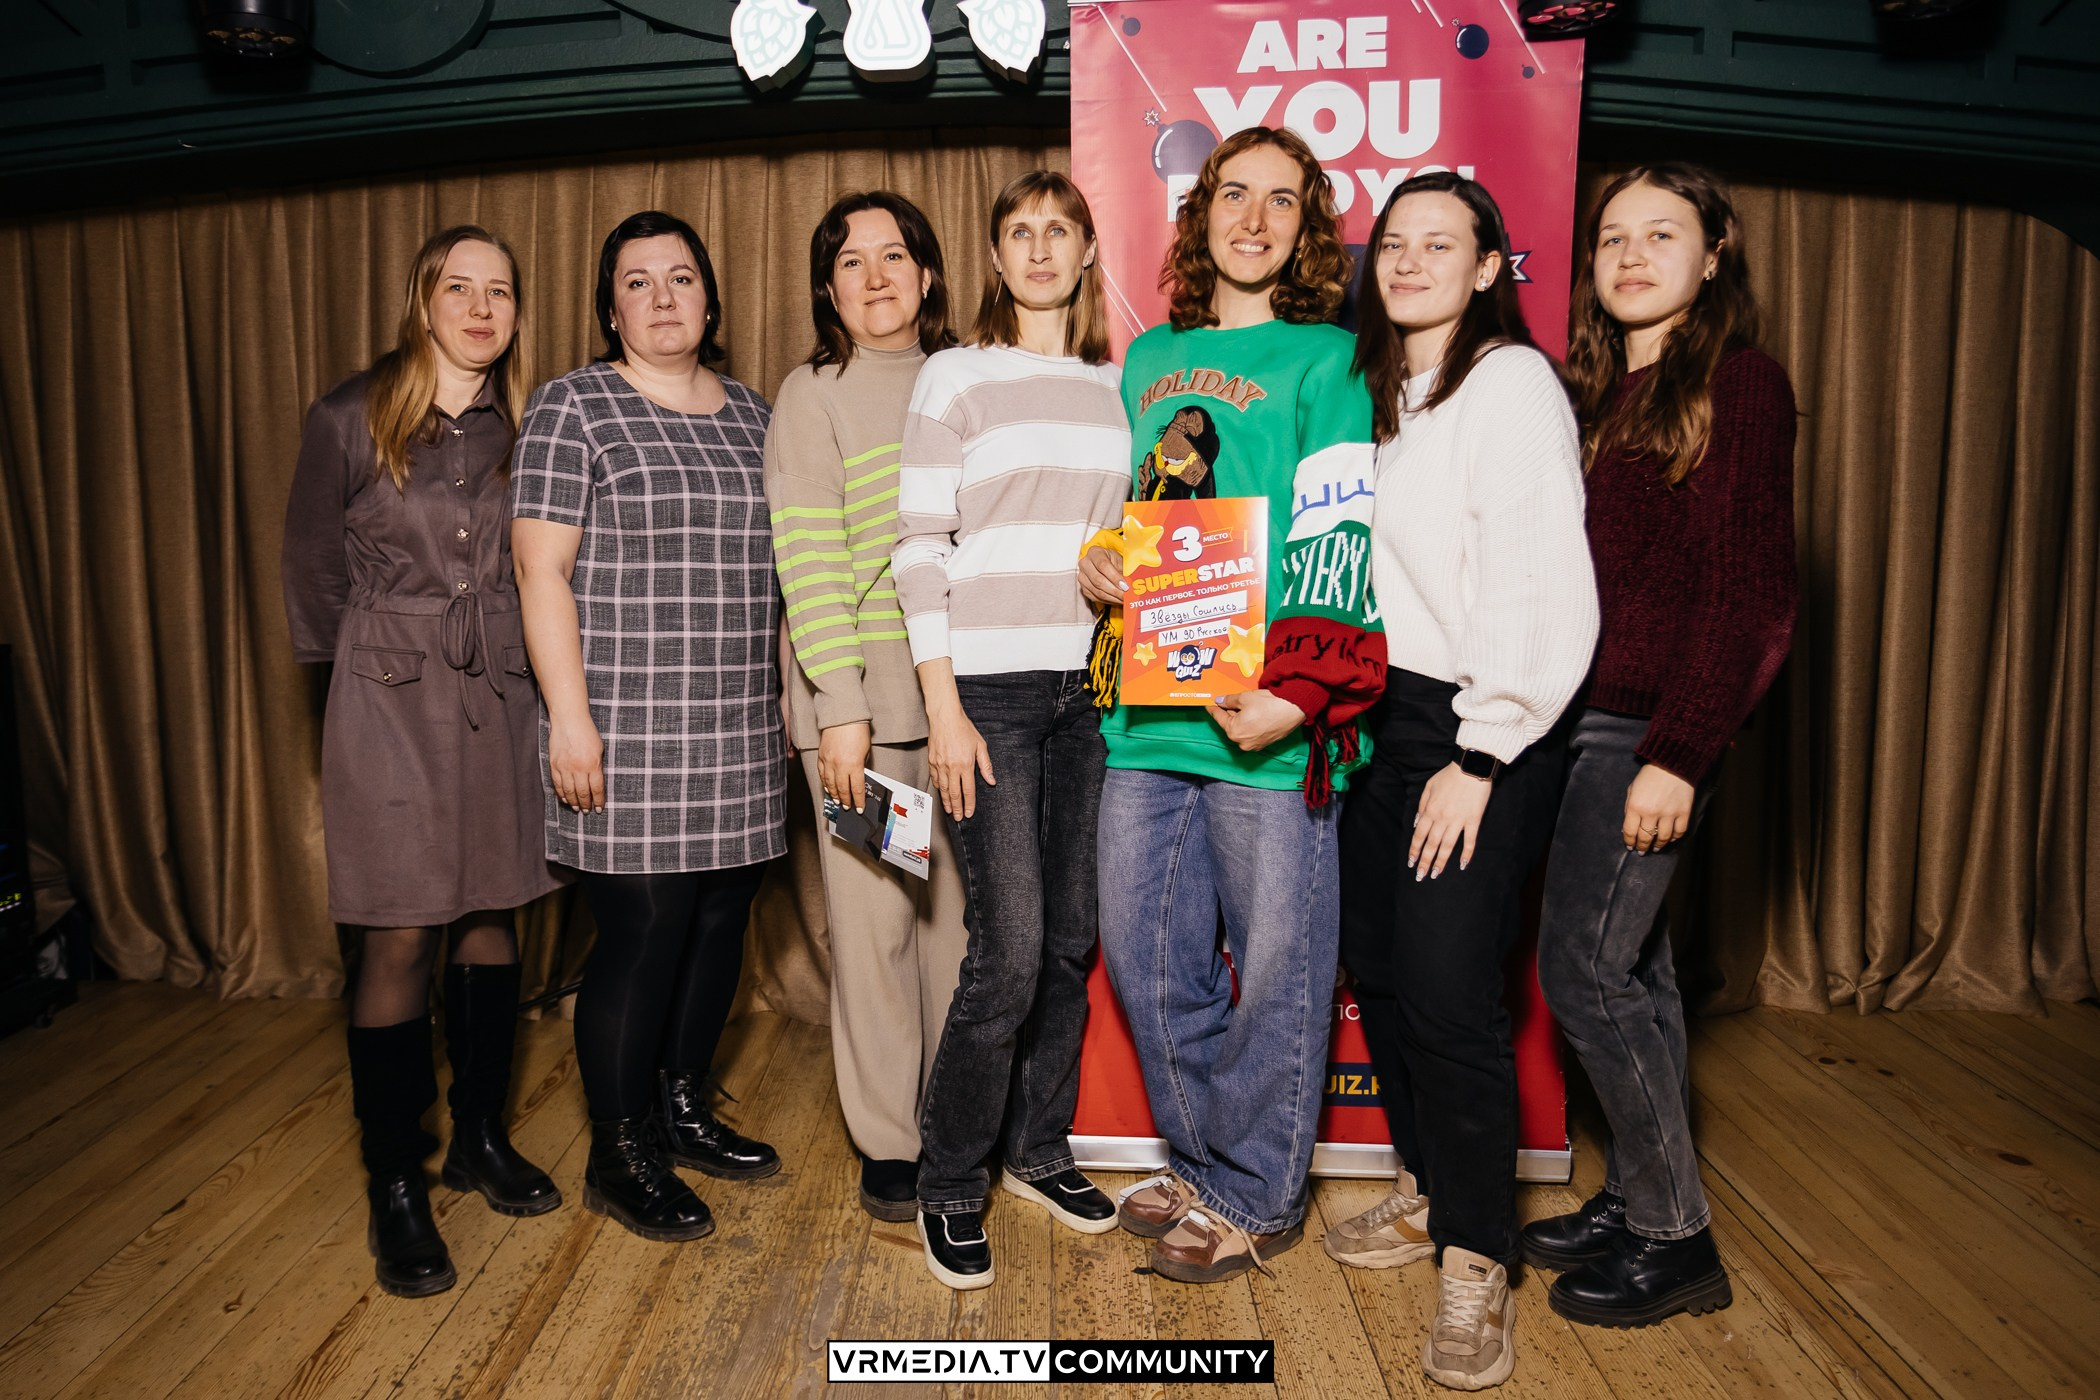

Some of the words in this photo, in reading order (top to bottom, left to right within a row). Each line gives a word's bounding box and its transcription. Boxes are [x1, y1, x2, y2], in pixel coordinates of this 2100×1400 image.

[1237, 16, 1388, 73] ARE
[1193, 78, 1441, 161] YOU
[1139, 368, 1267, 418] HOLIDAY
[1171, 525, 1204, 562] 3
[1202, 532, 1229, 543] МЕСТО
[1129, 599, 1144, 609] ЭТО
[1145, 595, 1162, 606] КАК
[1163, 589, 1196, 602] ПЕРВОЕ,
[1196, 582, 1229, 596] ТОЛЬКО
[1230, 577, 1262, 590] ТРЕТЬЕ
[1132, 556, 1256, 596] SUPERSTAR
[1175, 664, 1202, 679] QUIZ
